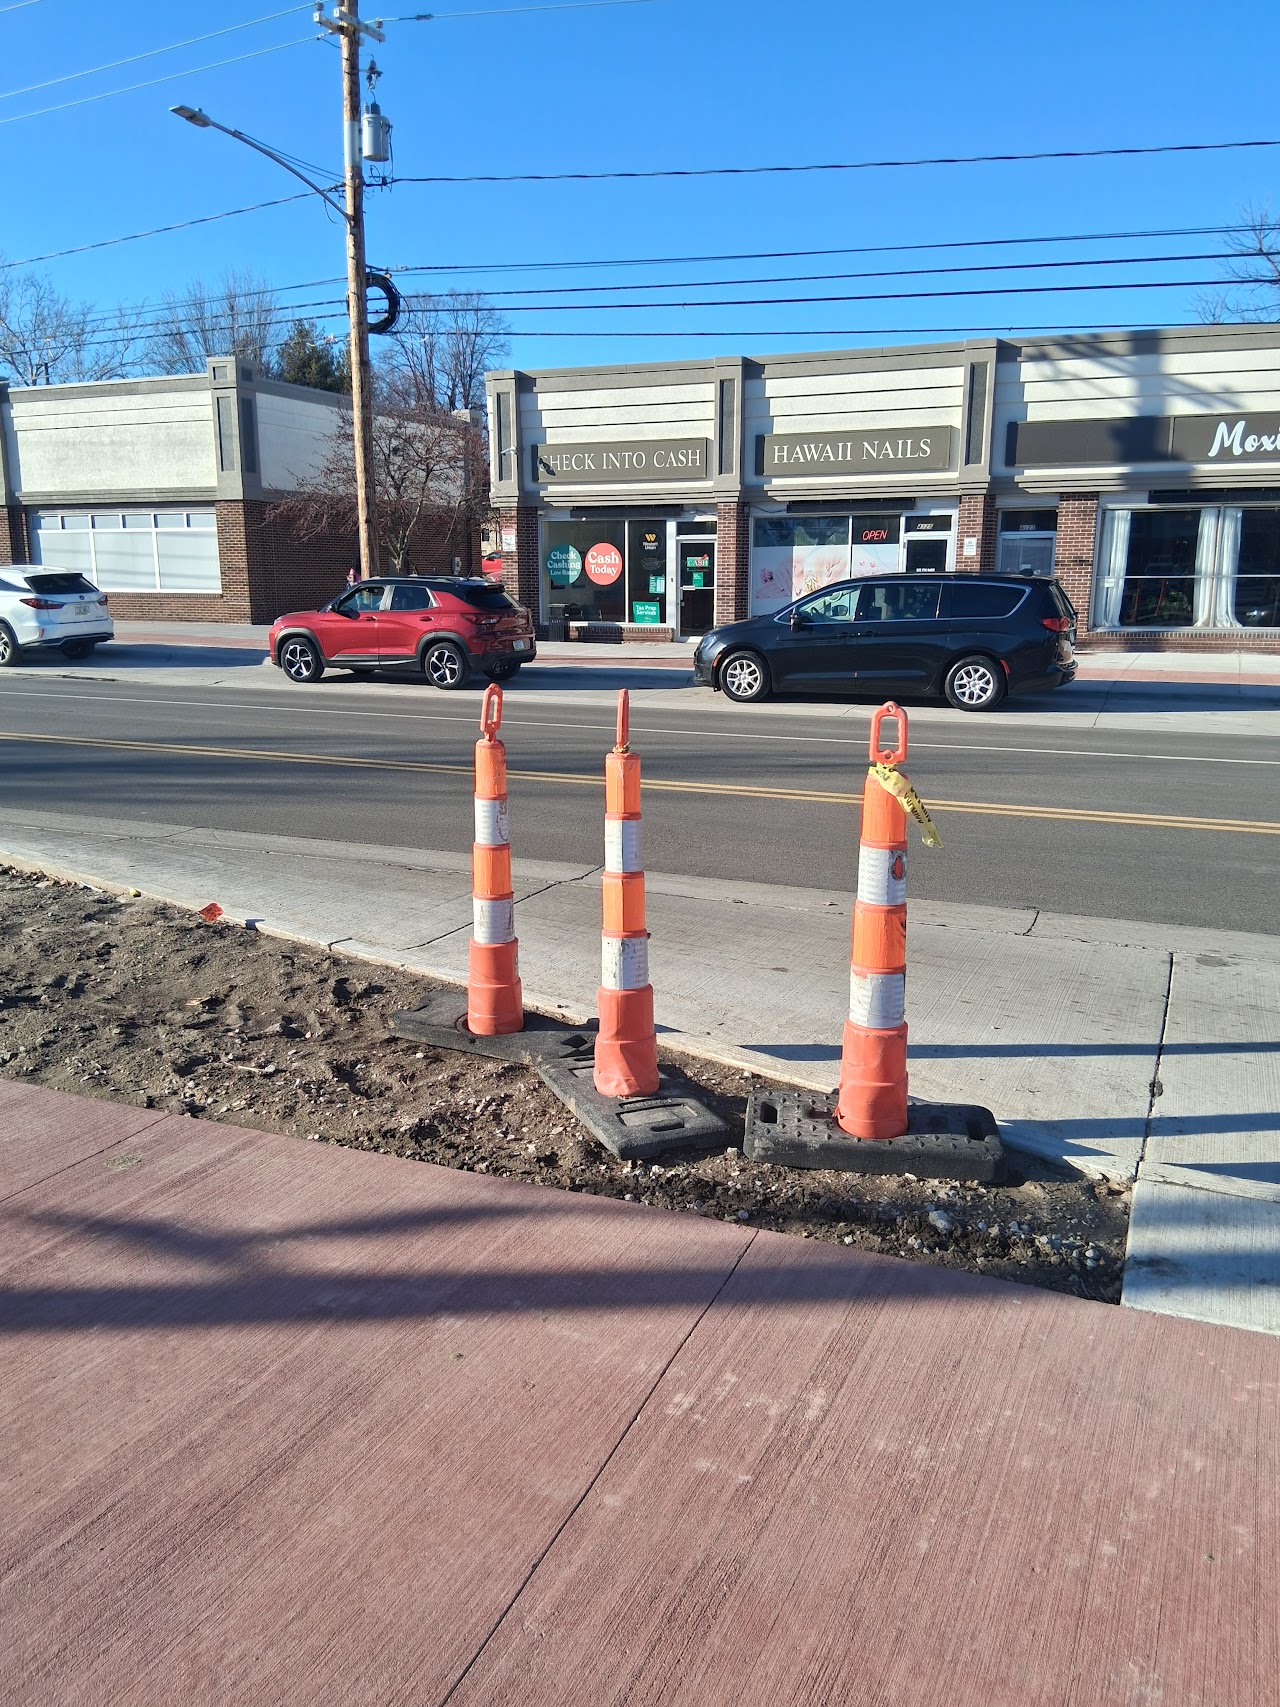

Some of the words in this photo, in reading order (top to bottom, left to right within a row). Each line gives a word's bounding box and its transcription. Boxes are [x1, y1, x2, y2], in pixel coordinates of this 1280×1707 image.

[772, 442, 853, 464] HAWAII
[861, 438, 931, 460] NAILS
[602, 451, 646, 470] INTO
[653, 449, 701, 468] CASH
[862, 529, 888, 541] OPEN
[550, 551, 577, 560] Check
[588, 551, 619, 564] Cash
[547, 560, 581, 569] Cashing
[589, 564, 618, 576] Today
